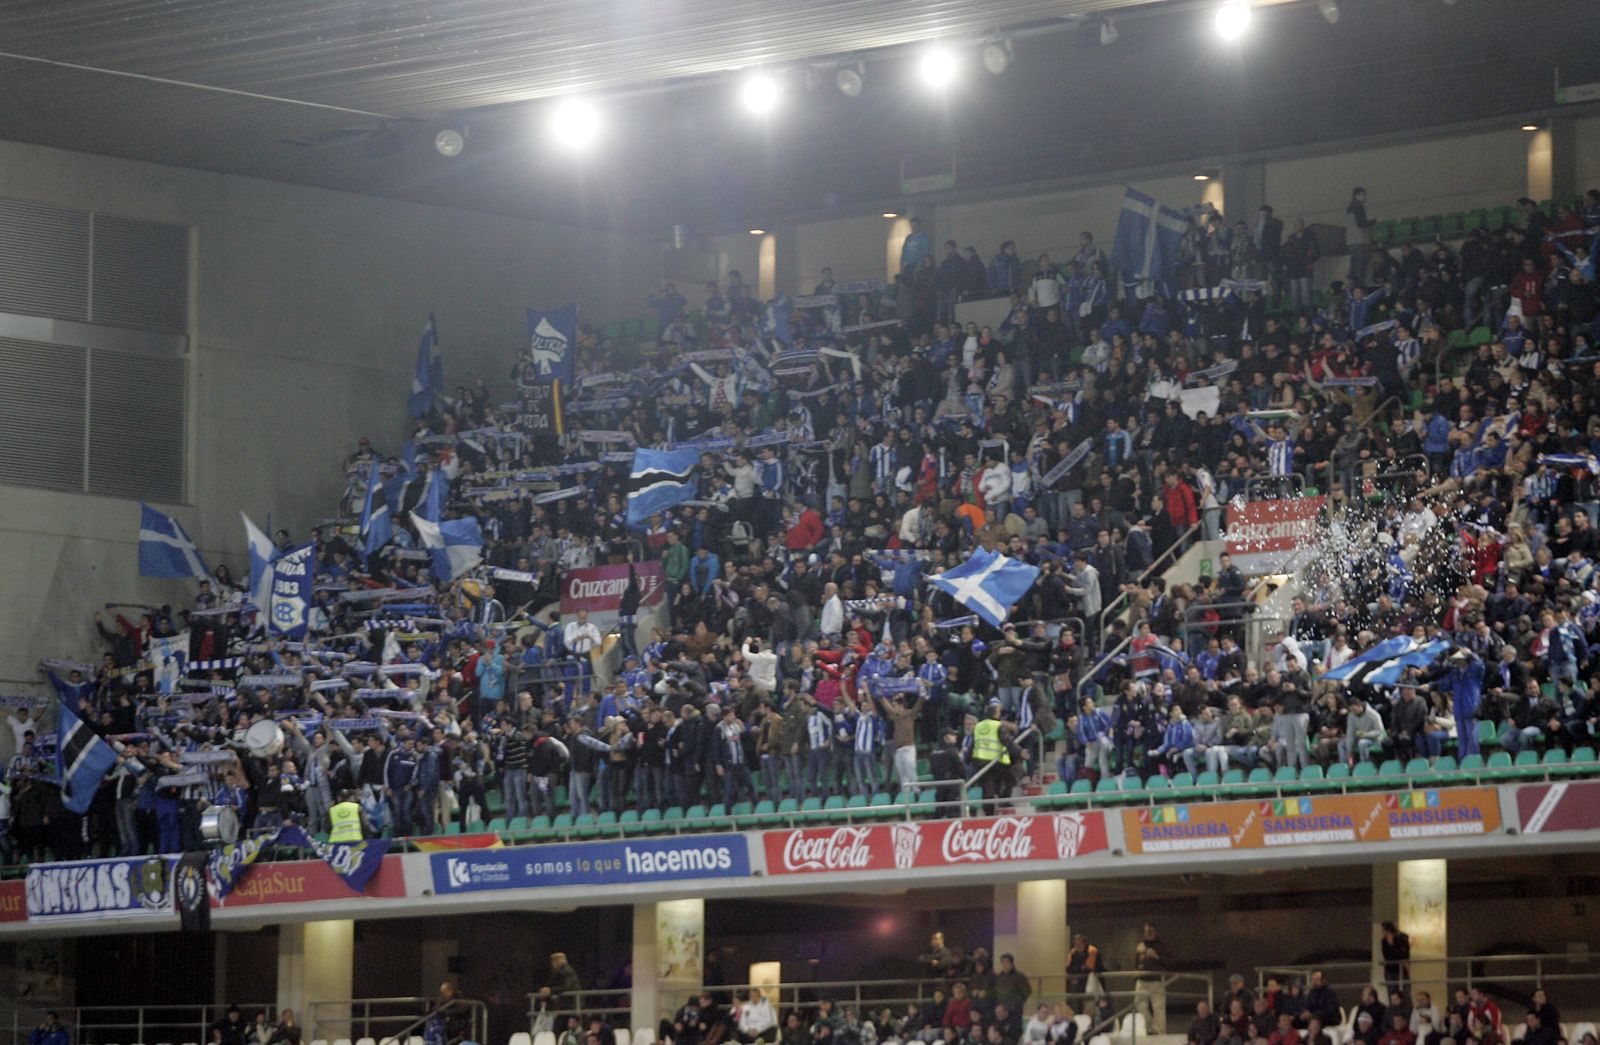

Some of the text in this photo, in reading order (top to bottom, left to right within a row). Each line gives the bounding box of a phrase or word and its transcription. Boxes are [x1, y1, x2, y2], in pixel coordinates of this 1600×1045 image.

[1202, 562, 1211, 575] 2
[1263, 815, 1353, 832] SANSUEÑA
[1388, 806, 1483, 825] SANSUEÑA
[1141, 820, 1229, 839] SANSUEÑA
[525, 847, 732, 875] somos lo que hacemos
